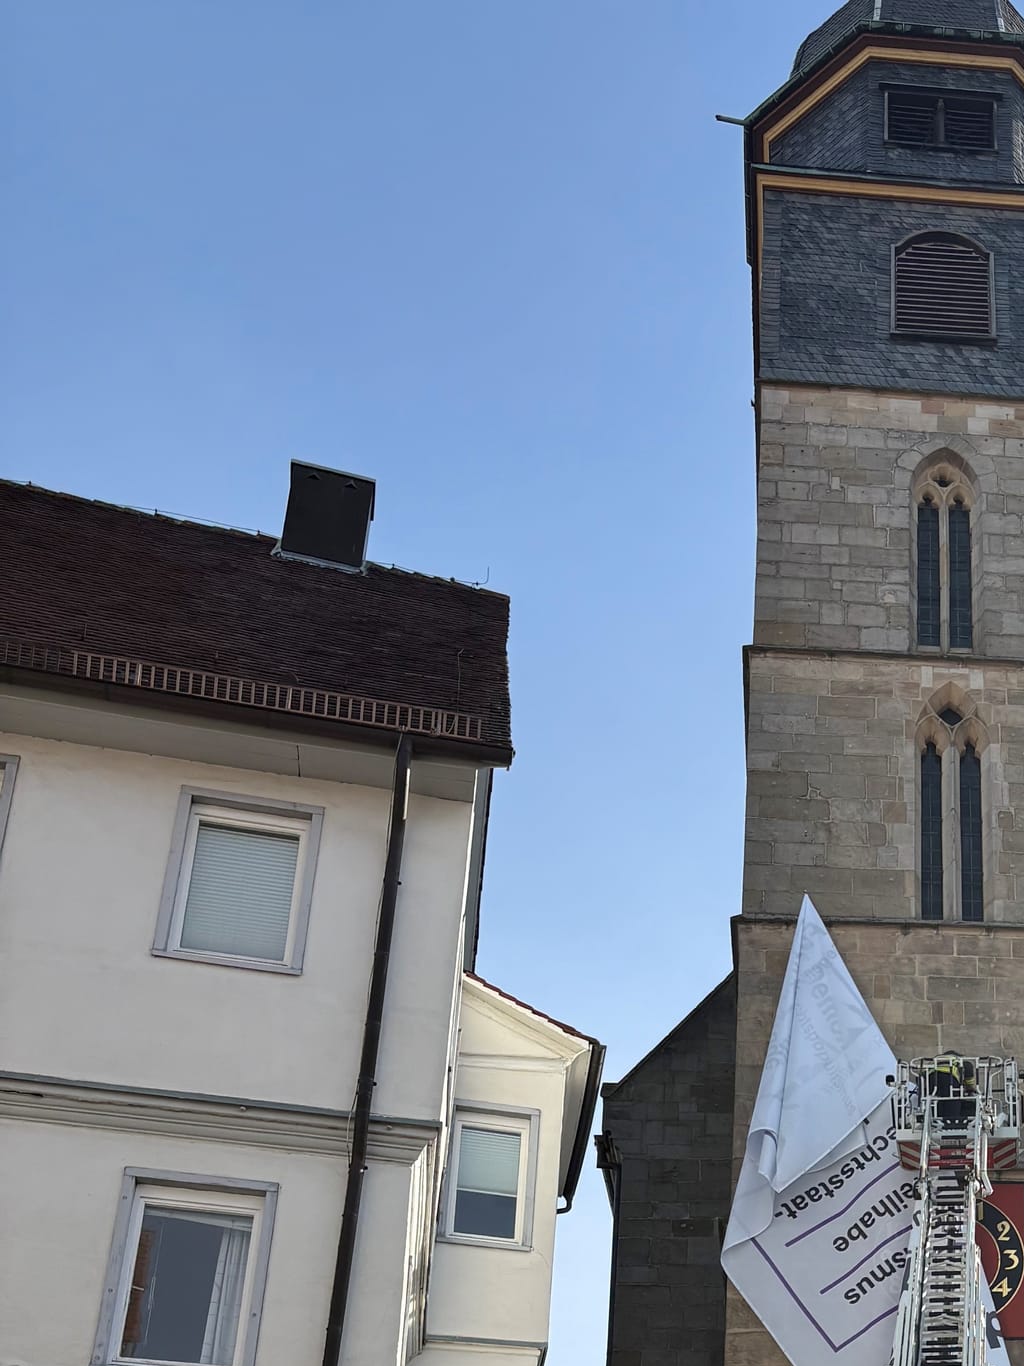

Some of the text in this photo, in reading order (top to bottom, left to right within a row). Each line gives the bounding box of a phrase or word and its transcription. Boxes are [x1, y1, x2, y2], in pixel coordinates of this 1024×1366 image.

[774, 1126, 897, 1219] echtsstaat-
[833, 1179, 916, 1252] eilhabe
[997, 1221, 1010, 1241] 2
[844, 1248, 911, 1304] smus
[1003, 1249, 1019, 1270] 3
[992, 1276, 1012, 1298] 4
